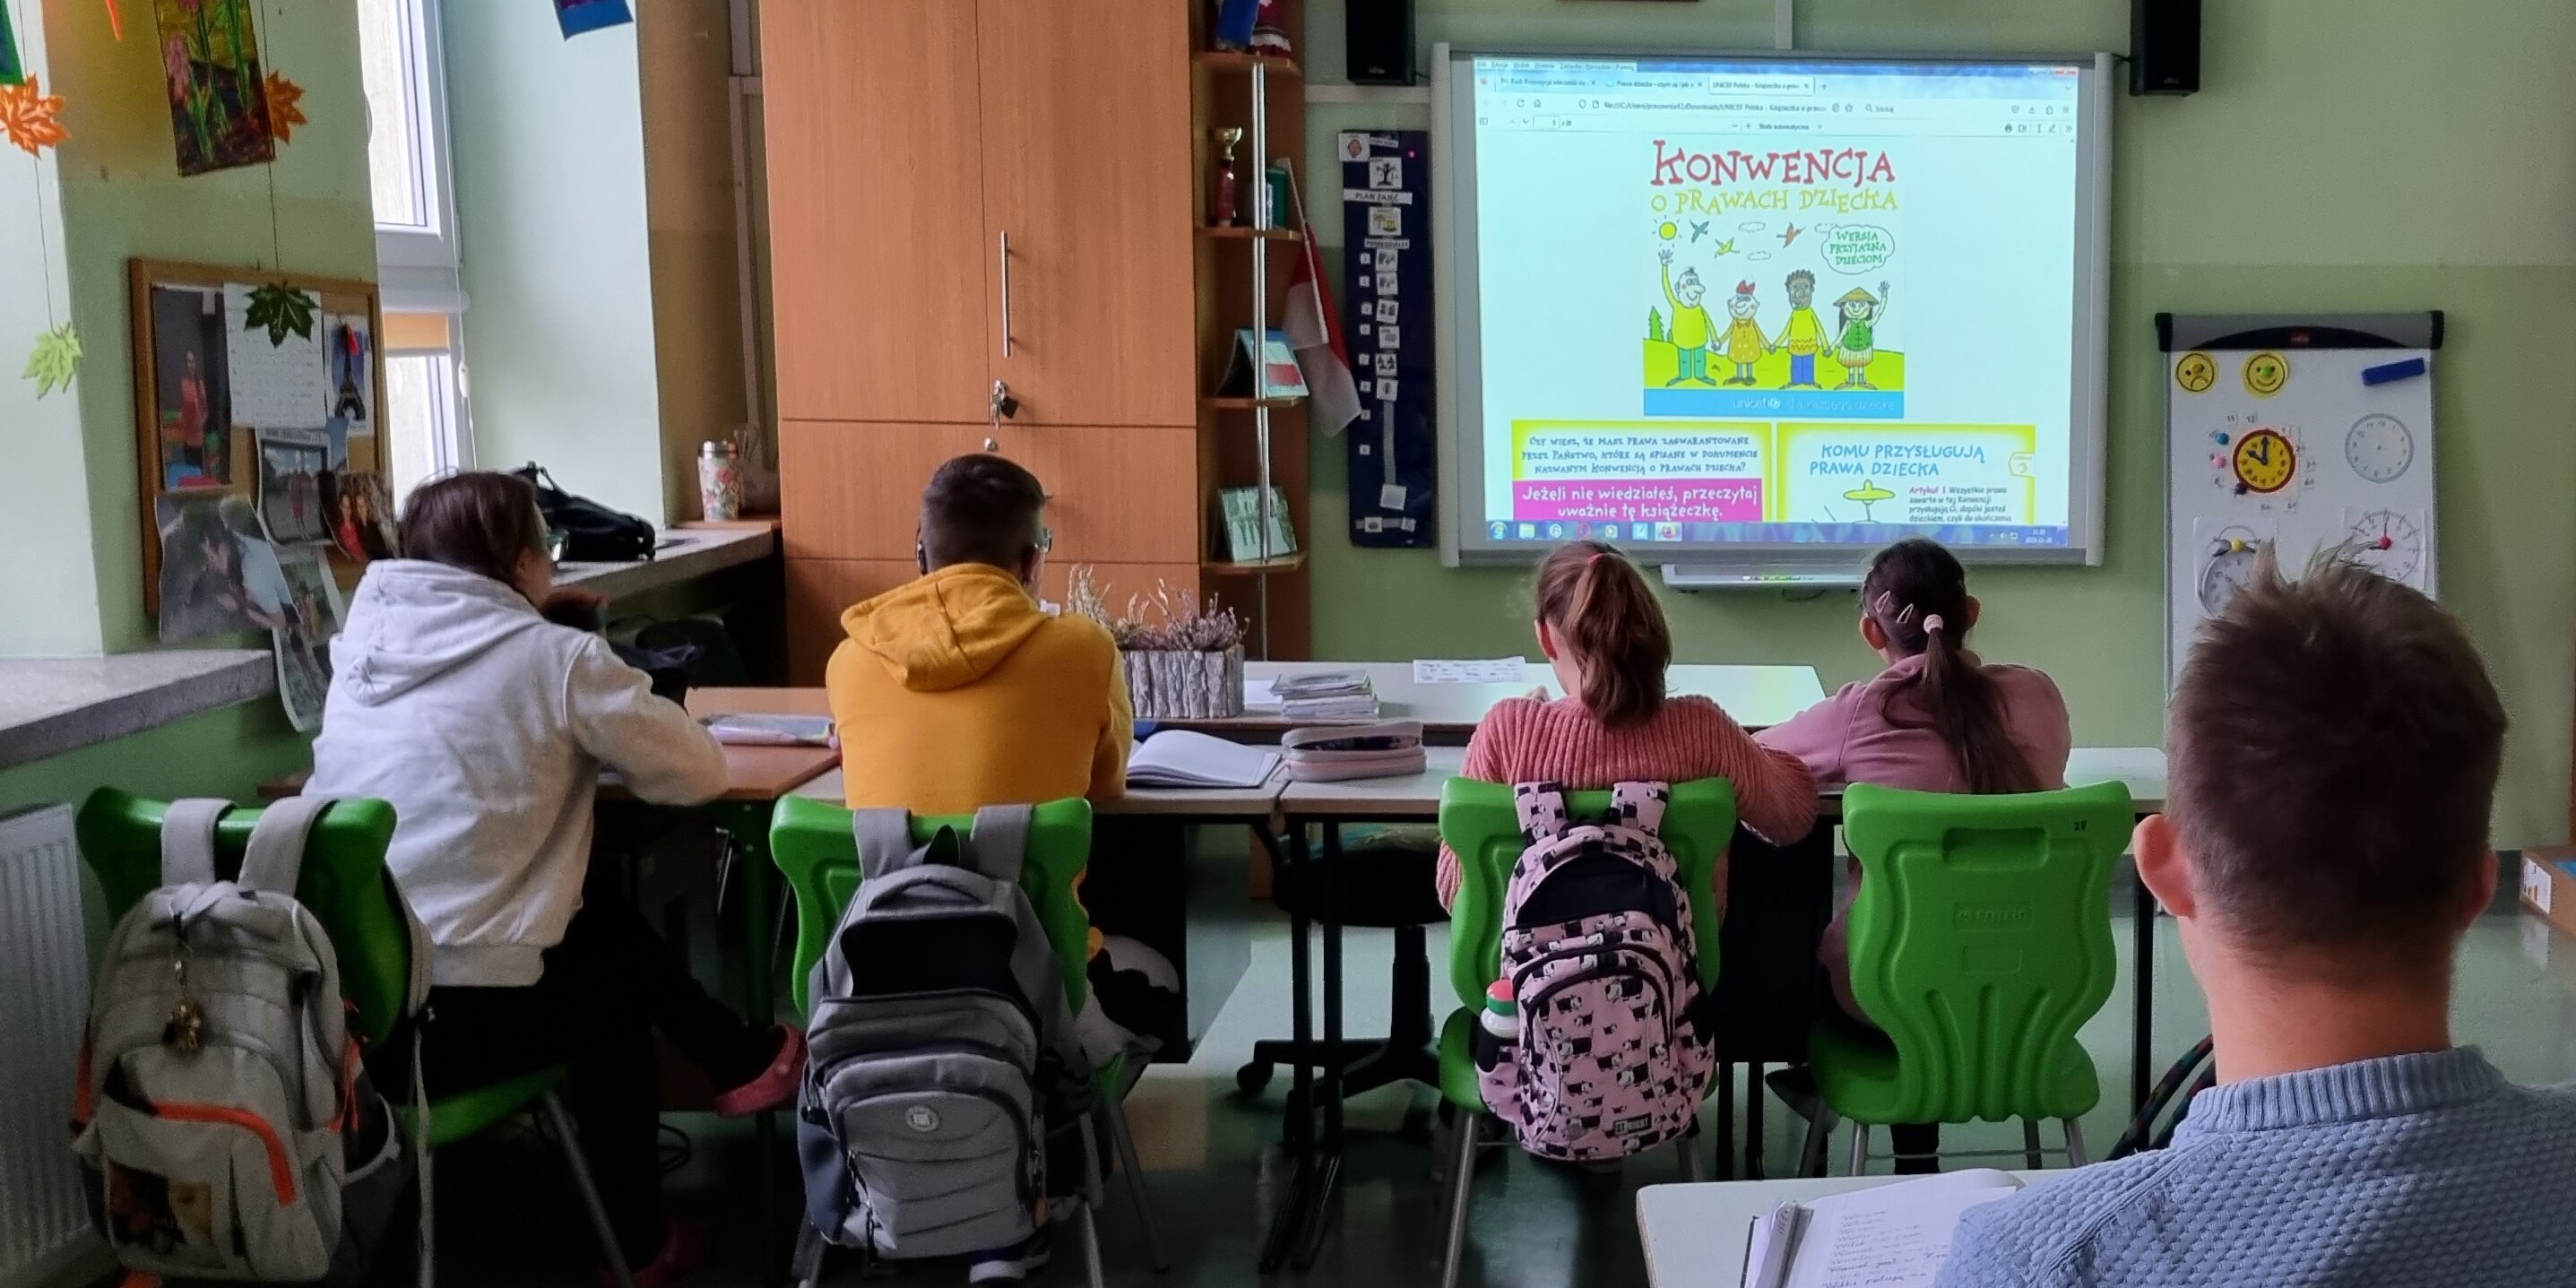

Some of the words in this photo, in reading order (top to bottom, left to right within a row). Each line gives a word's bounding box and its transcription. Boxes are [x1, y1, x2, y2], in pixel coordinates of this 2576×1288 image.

[1650, 140, 1896, 188] KONWENCJA
[1355, 192, 1375, 201] PLAN
[1674, 188, 1789, 215] PRAWACH
[1799, 187, 1897, 214] DZIECKA
[1836, 230, 1879, 243] WERSJA
[1836, 253, 1883, 265] DZIECIOM
[1821, 445, 1870, 459] KOMU
[1874, 444, 1985, 464] PRZYSŁUGUJĄ
[1810, 461, 1864, 476] PRAWA
[1871, 462, 1940, 476] DZIECKA
[1522, 486, 1566, 501] Jeżeli
[1571, 488, 1594, 500] nie
[1598, 485, 1678, 502] wiedziałeś,
[1682, 485, 1758, 506] przeczytaj
[1949, 486, 1984, 496] Wszystkie
[1558, 503, 1617, 518] uważnie
[1621, 504, 1637, 521] tę
[1640, 503, 1724, 521] książeczkę.
